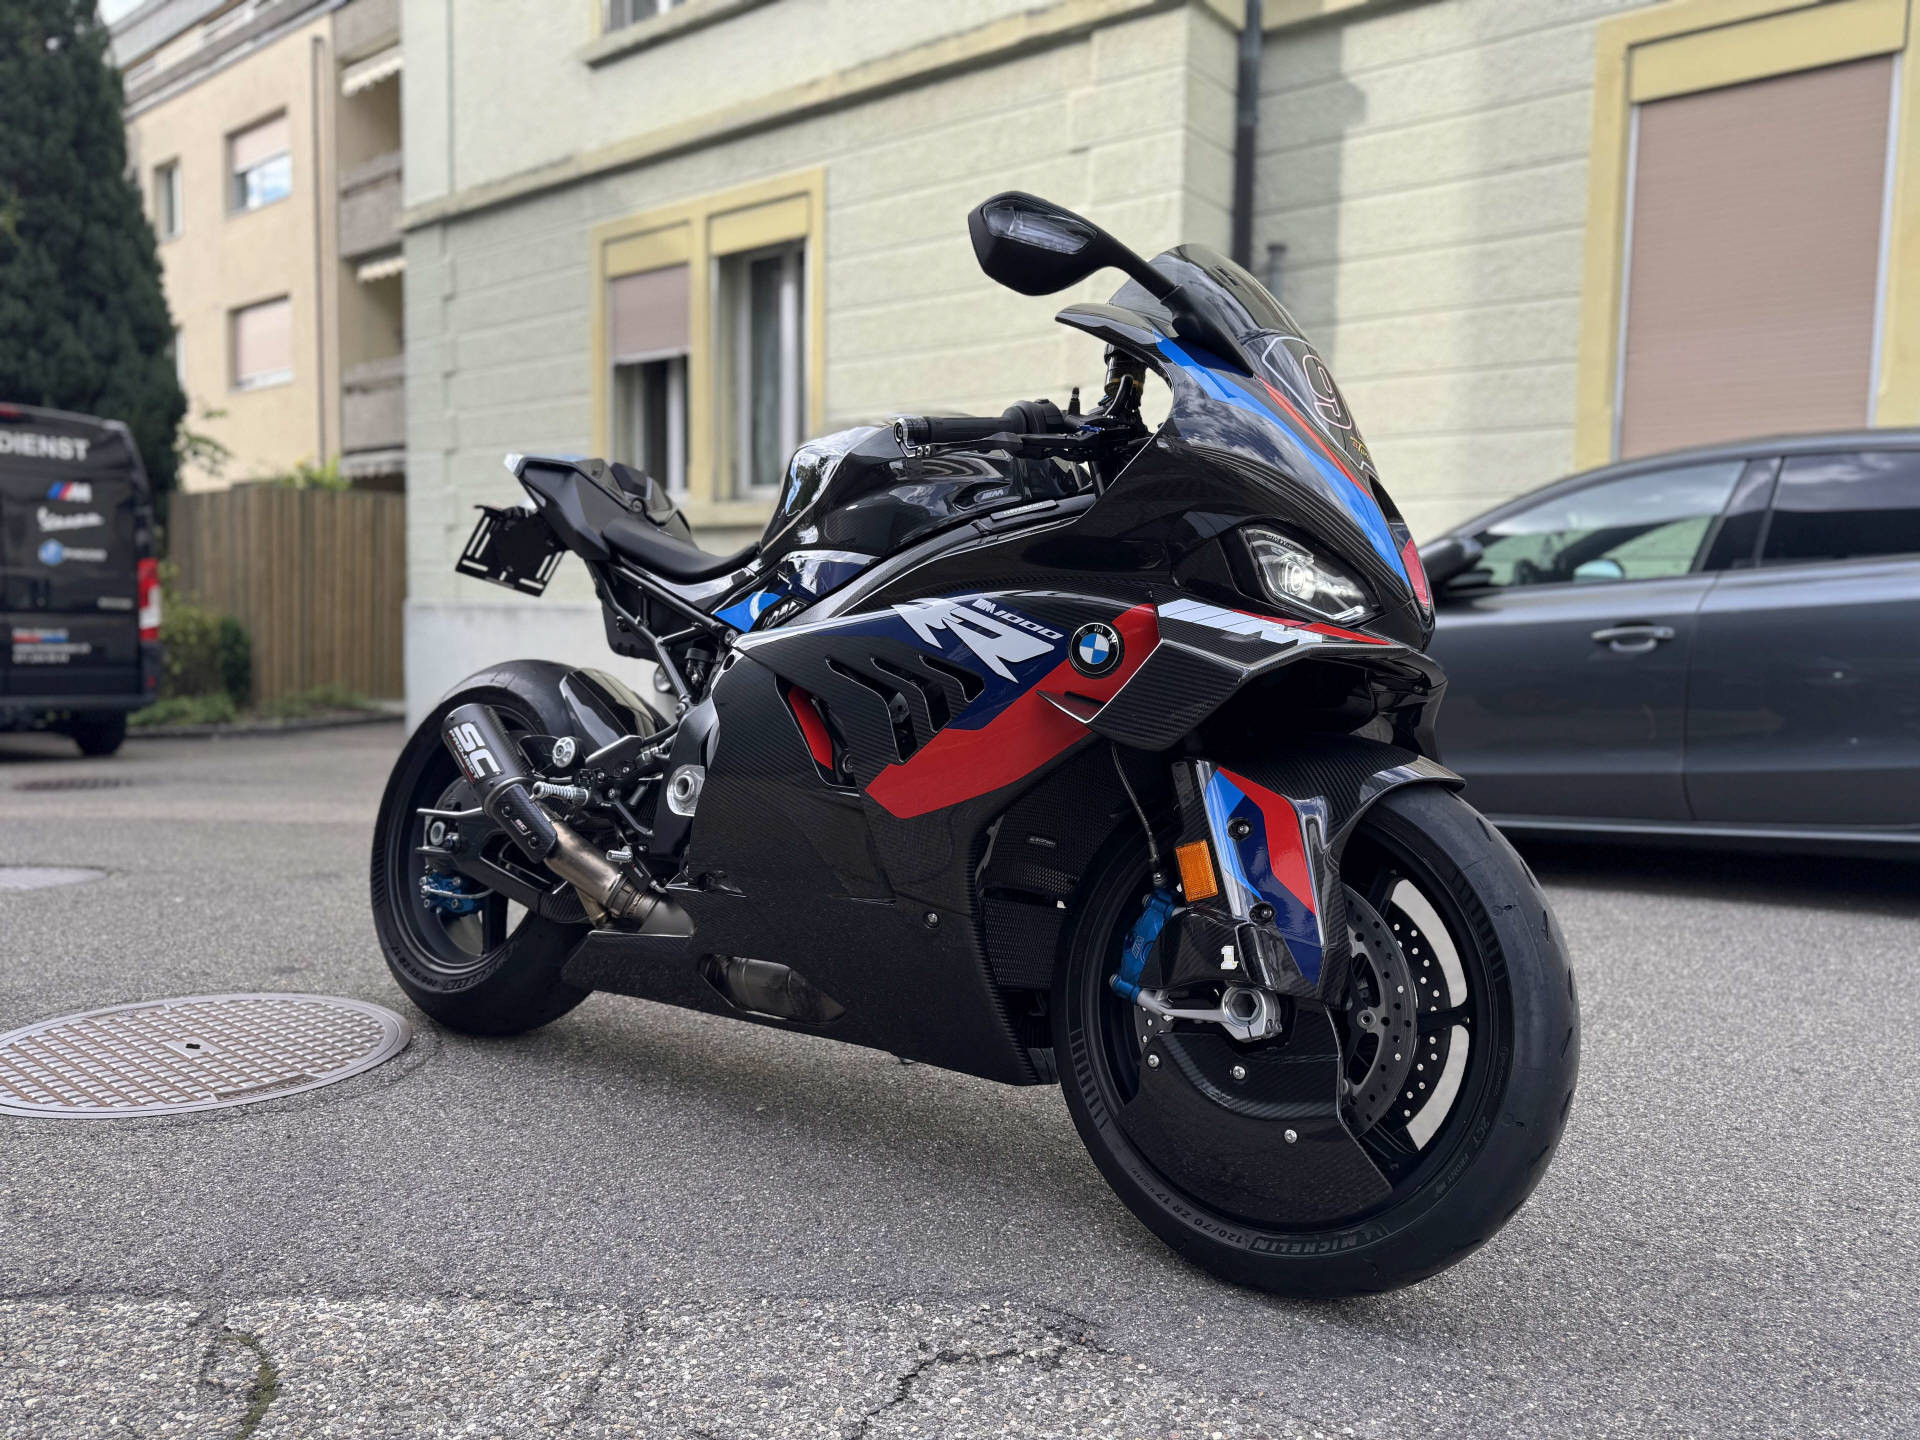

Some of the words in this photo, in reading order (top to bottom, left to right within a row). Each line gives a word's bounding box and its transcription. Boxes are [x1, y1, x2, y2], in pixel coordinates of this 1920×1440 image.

[0, 430, 91, 461] DIENST
[1220, 945, 1239, 970] 1
[1155, 1189, 1171, 1202] 17
[1171, 1204, 1189, 1220] ZR
[1193, 1218, 1244, 1243] 120/70
[1253, 1236, 1359, 1254] MICHELIN
